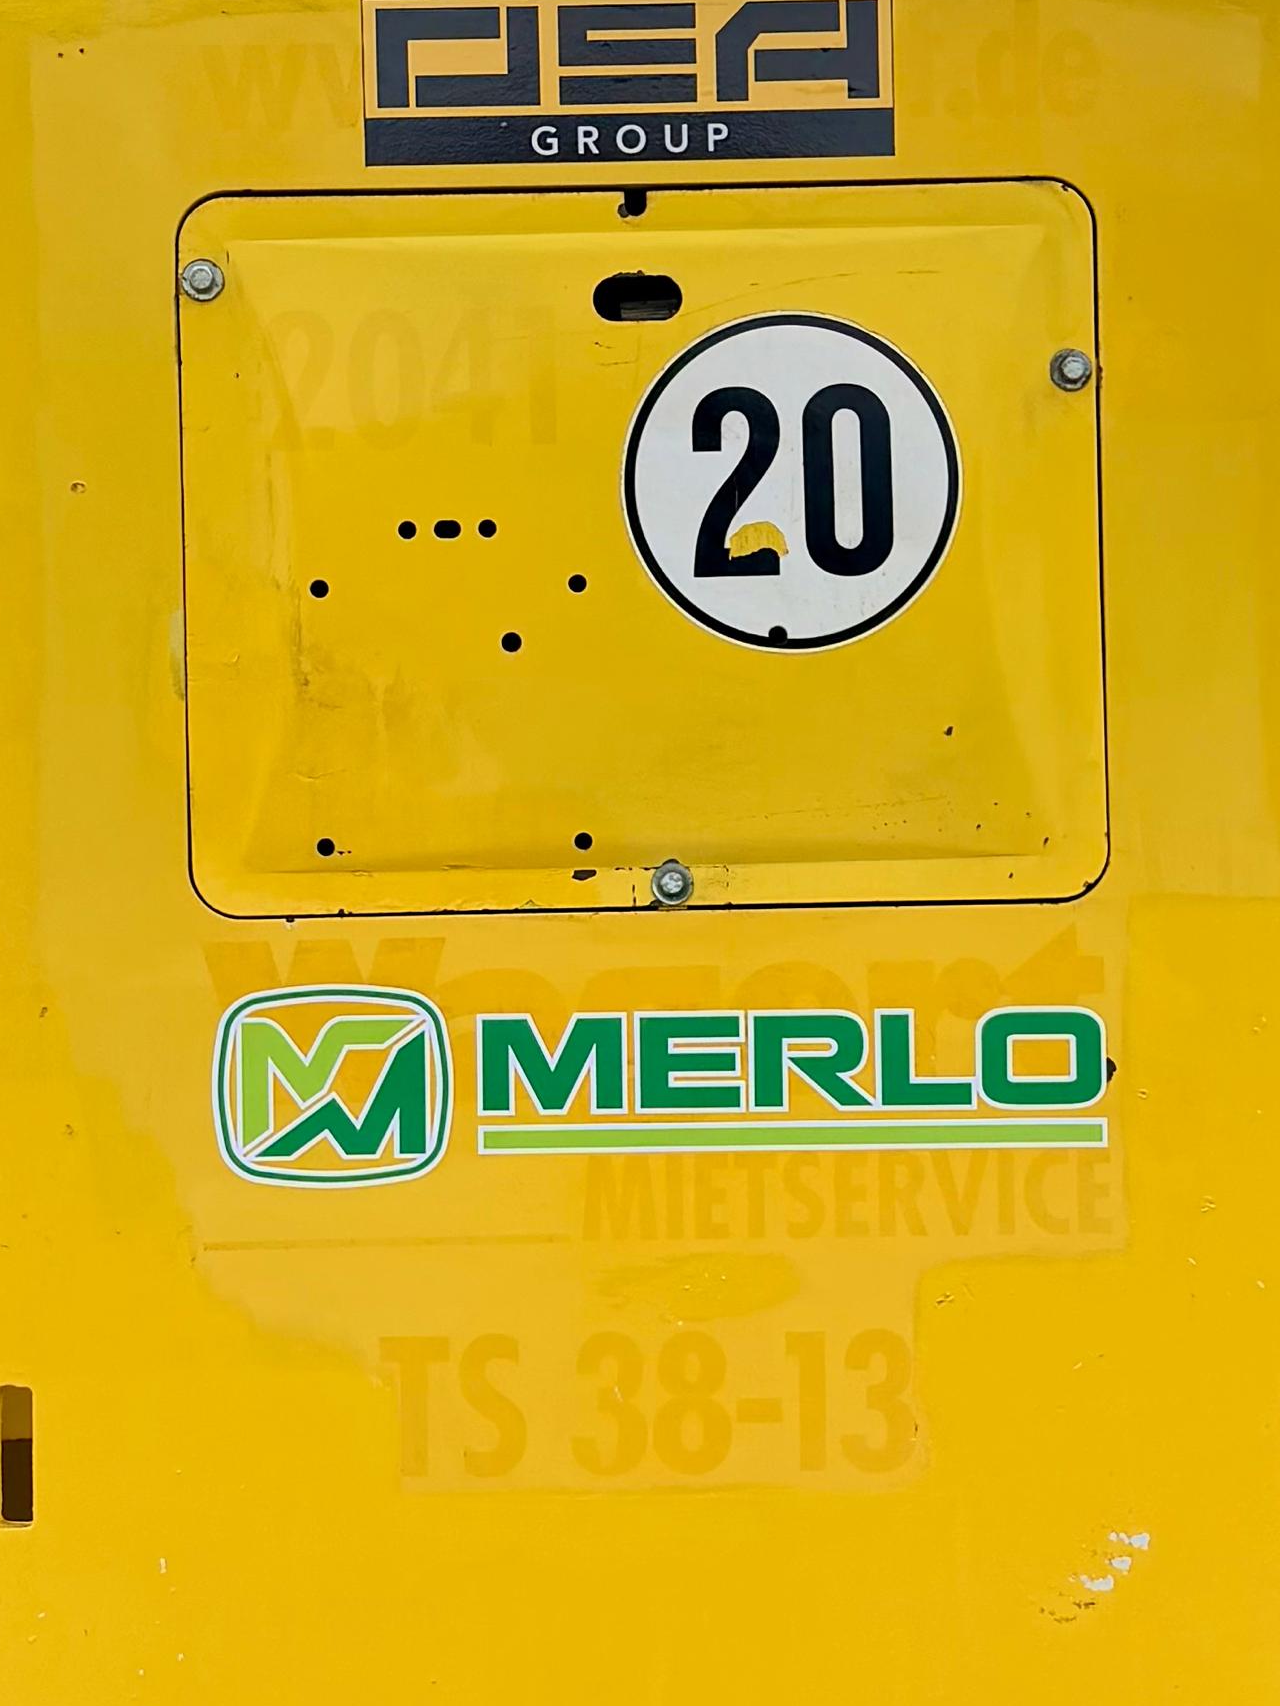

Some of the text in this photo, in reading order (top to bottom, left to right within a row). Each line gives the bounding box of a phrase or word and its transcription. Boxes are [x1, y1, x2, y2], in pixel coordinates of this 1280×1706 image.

[530, 121, 730, 157] GROUP
[691, 382, 895, 579] 20
[475, 1004, 1110, 1116] MERLO
[581, 1148, 1114, 1242] MIETSERVICE
[378, 1327, 917, 1478] TS 38-13
